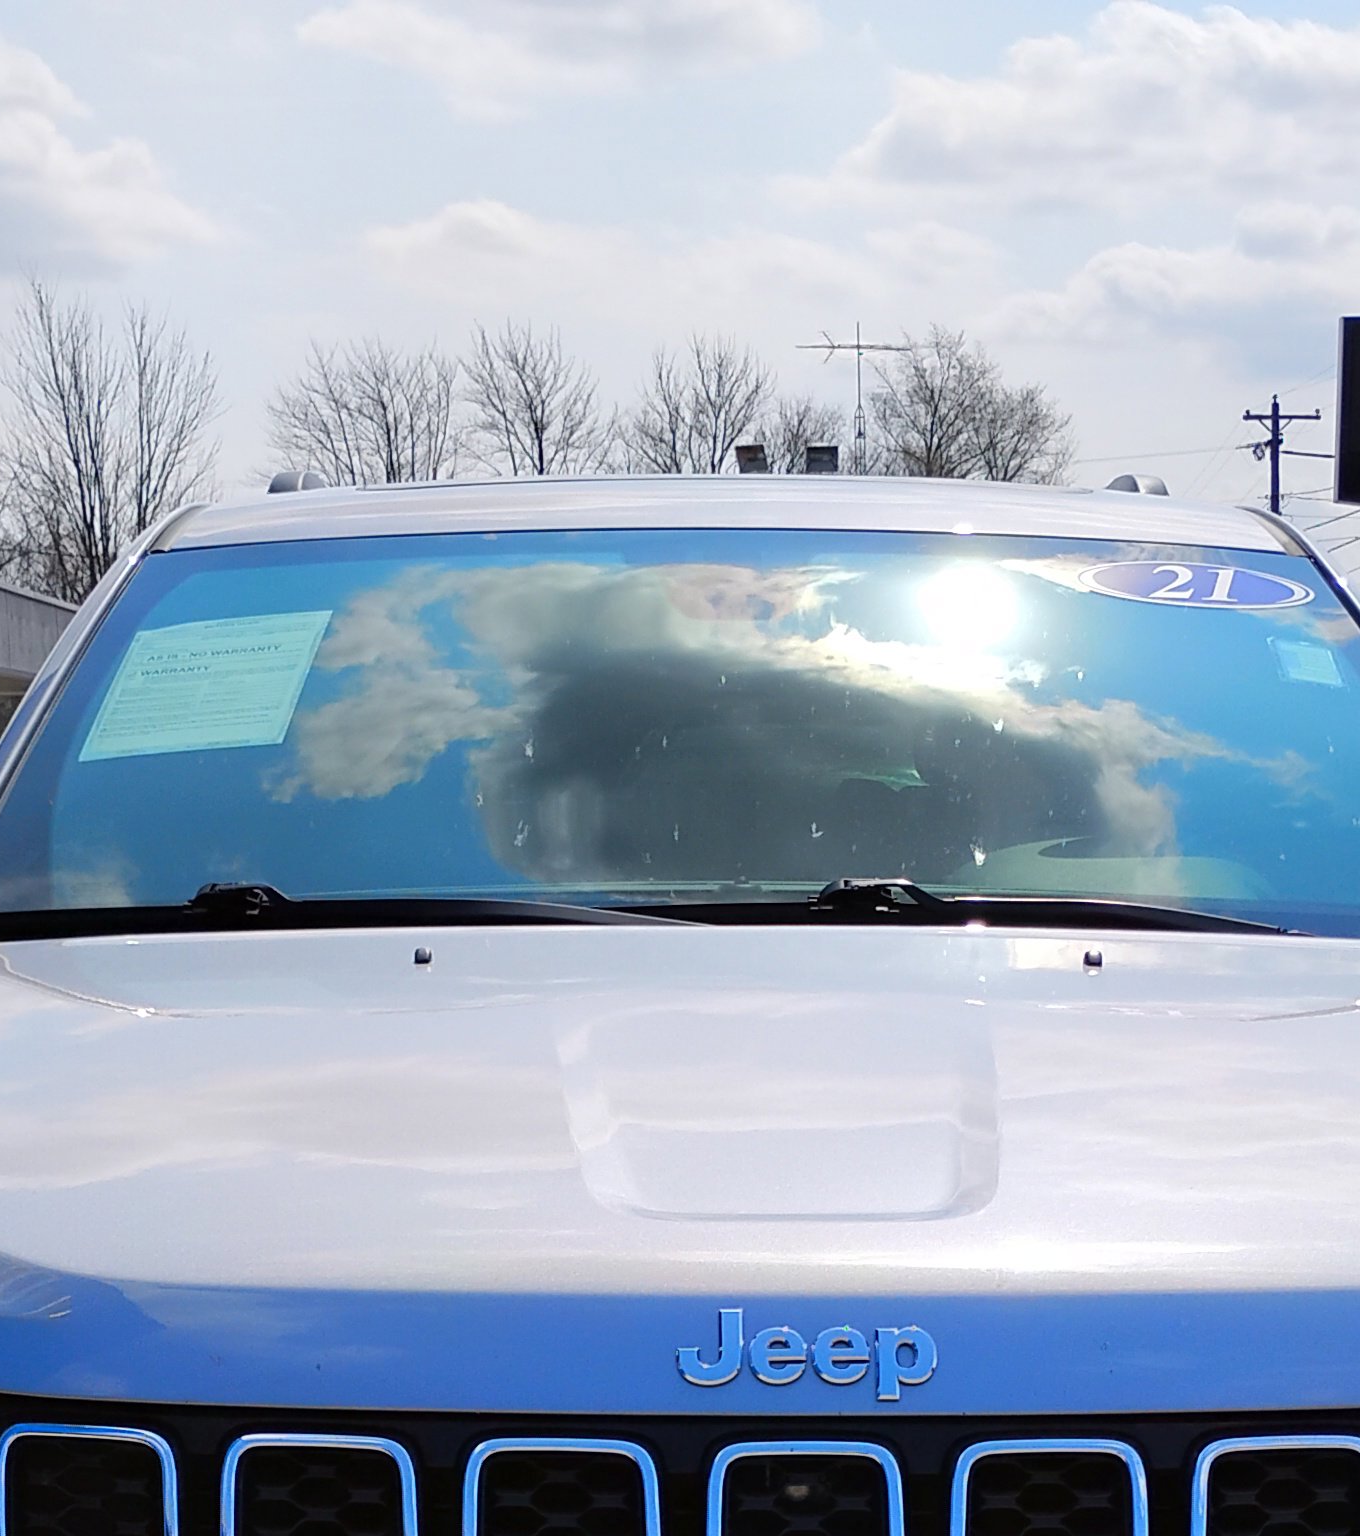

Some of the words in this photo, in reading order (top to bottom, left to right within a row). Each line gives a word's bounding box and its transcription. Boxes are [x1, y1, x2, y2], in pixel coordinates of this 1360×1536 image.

[1149, 565, 1238, 602] 21
[211, 645, 281, 656] WARRANTY
[141, 666, 209, 676] WARRANTY
[676, 1308, 938, 1401] Jeep
